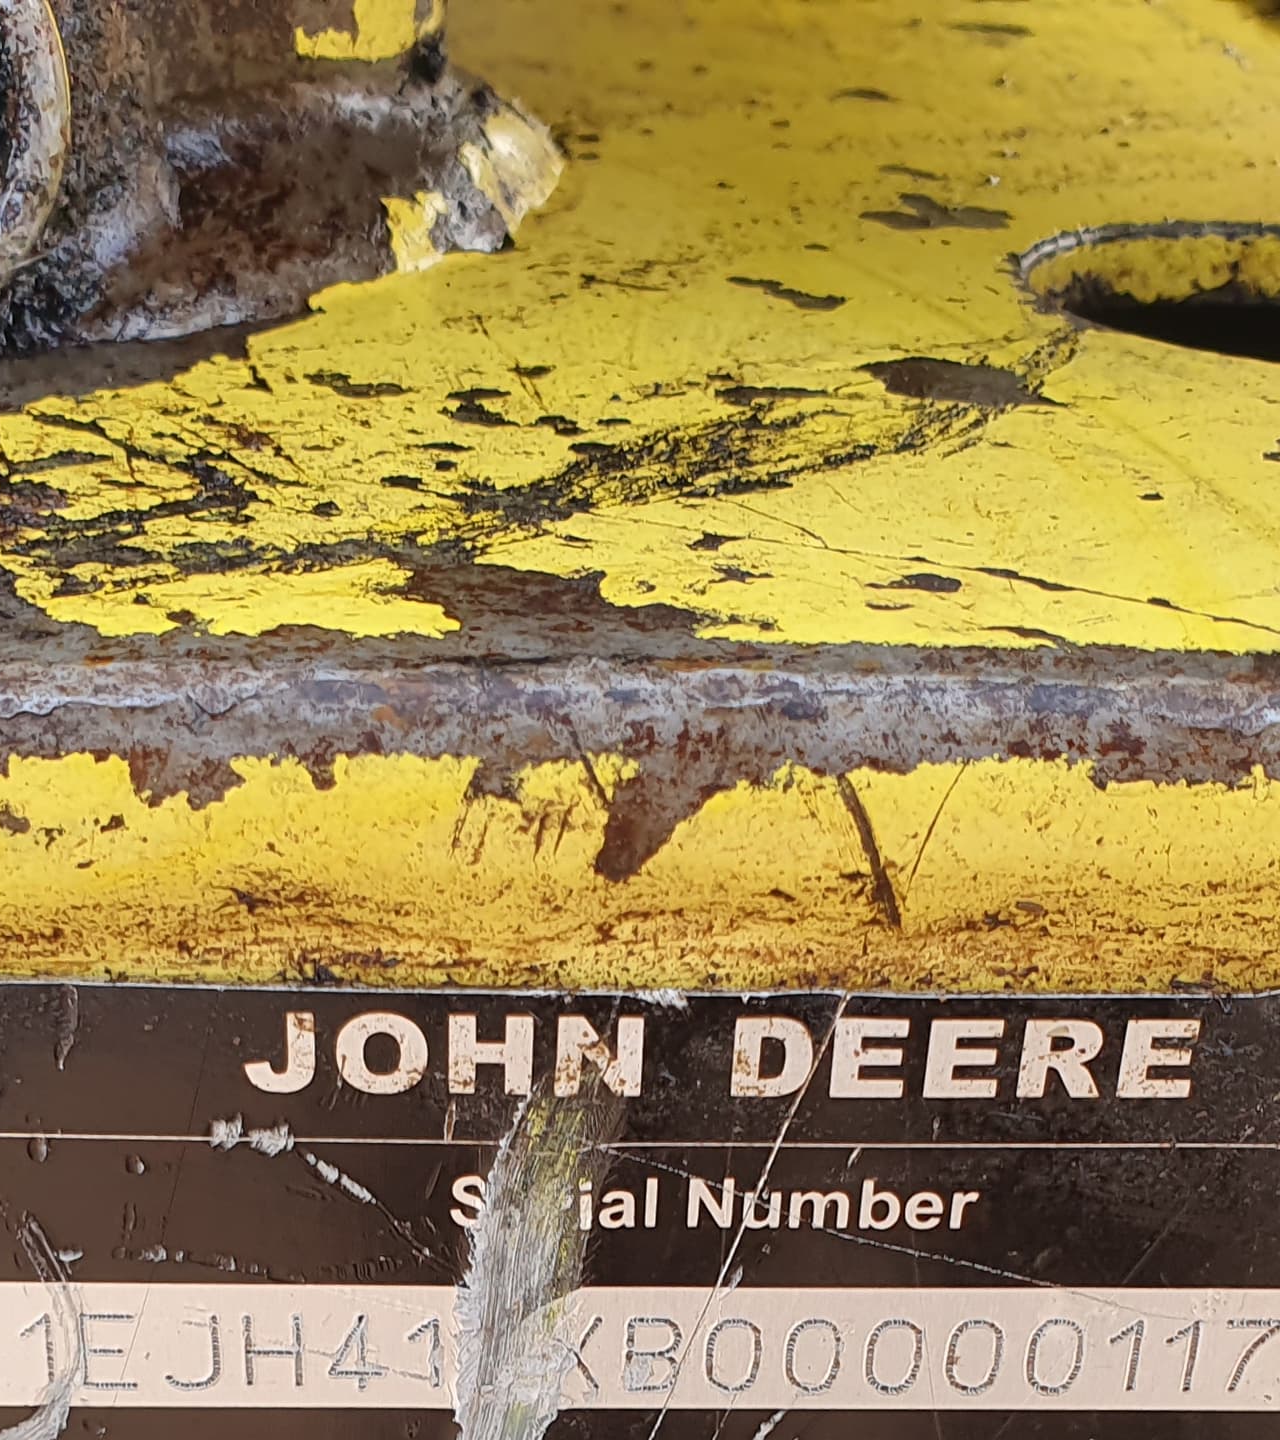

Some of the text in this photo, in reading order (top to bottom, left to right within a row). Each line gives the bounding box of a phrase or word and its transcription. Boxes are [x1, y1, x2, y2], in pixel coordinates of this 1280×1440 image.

[244, 1010, 1202, 1101] JOHN DEERE
[449, 1175, 979, 1231] Sial Number
